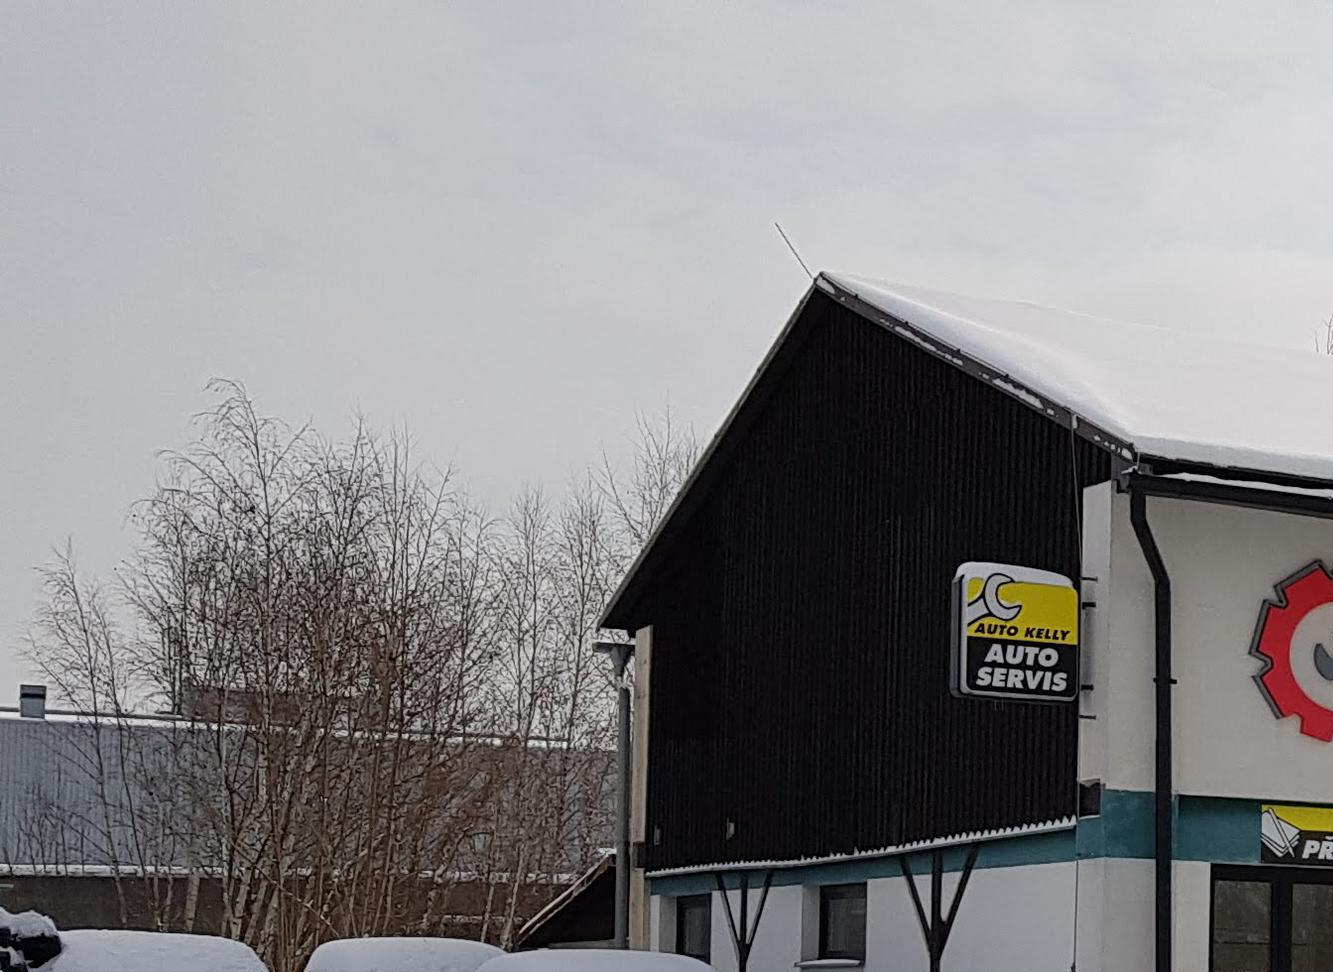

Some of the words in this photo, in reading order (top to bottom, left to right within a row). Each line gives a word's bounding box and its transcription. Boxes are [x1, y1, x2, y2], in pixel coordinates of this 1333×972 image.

[974, 623, 1018, 636] AUTO
[1024, 627, 1070, 640] KELLY
[984, 643, 1059, 667] AUTO
[976, 666, 1068, 692] SERVIS
